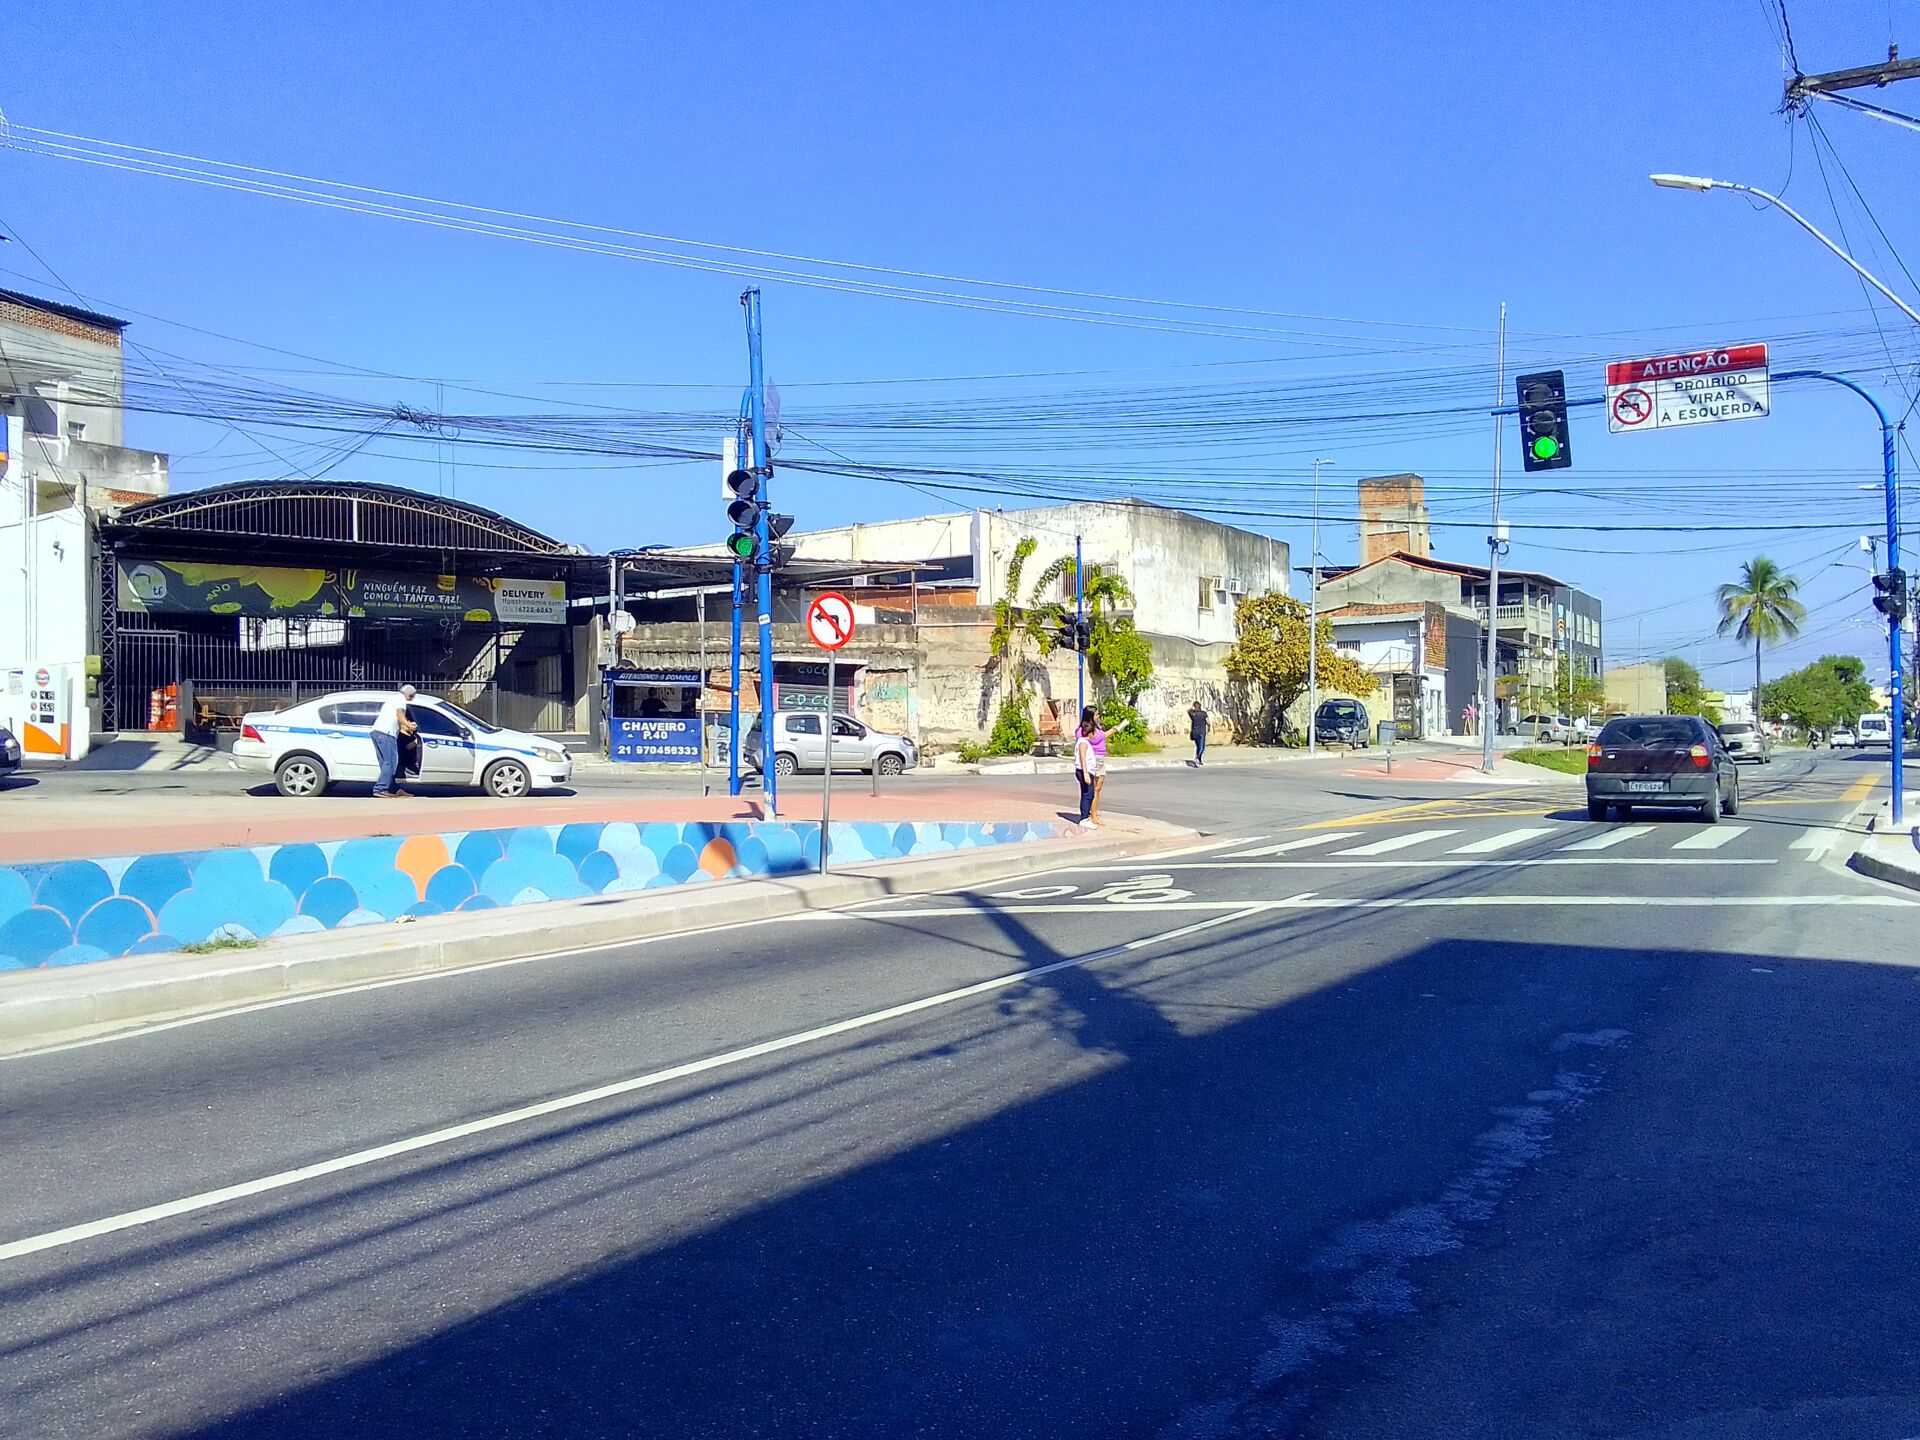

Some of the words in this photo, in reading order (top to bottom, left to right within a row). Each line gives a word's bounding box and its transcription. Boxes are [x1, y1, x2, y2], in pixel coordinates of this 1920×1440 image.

[1643, 352, 1729, 377] ATENÇÃO
[1674, 374, 1747, 392] PROIBIDO
[1688, 390, 1736, 404] VIRAR
[1661, 408, 1672, 422] À
[1678, 401, 1764, 420] ESQUERDA
[363, 581, 407, 593] NINGUÉM
[411, 585, 427, 594] FAZ
[502, 589, 545, 599] DELIVERY
[363, 591, 390, 601] COMO
[393, 593, 400, 602] A
[403, 593, 435, 603] TANTO
[438, 594, 460, 605] FAZ!
[622, 721, 686, 732] CHAVEIRO
[643, 731, 668, 740] P.40
[617, 745, 632, 755] 21
[636, 745, 698, 755] 970456333
